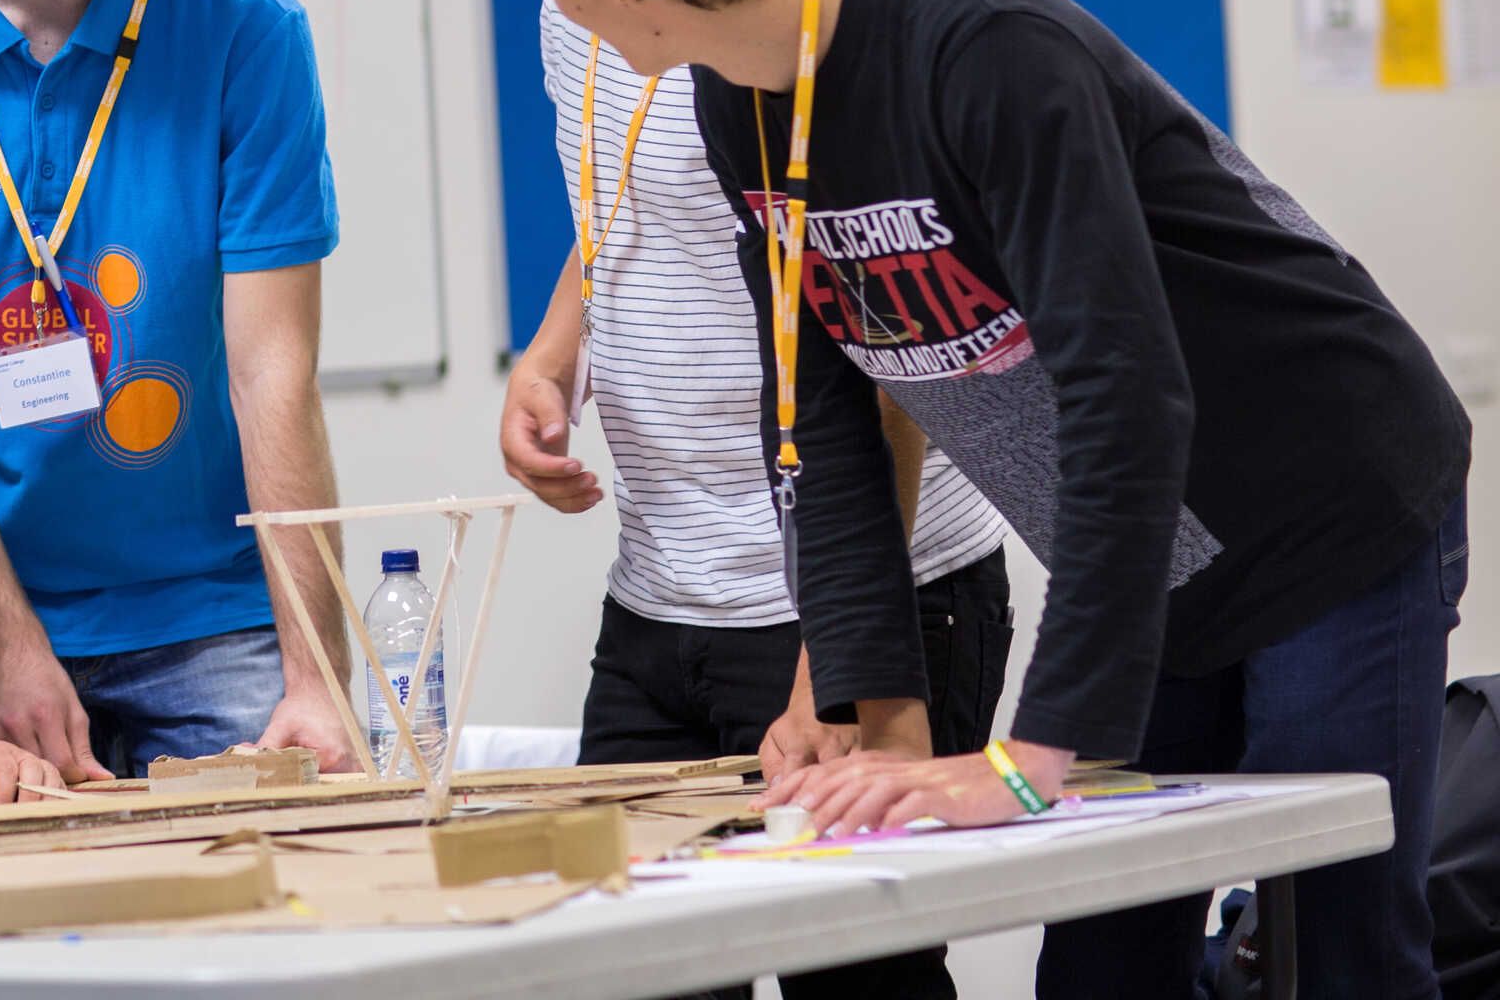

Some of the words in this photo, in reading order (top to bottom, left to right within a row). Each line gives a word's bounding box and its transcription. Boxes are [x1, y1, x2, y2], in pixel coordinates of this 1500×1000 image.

[1, 307, 97, 330] GLOBL
[12, 367, 72, 389] Constantine
[21, 391, 70, 409] Engineering
